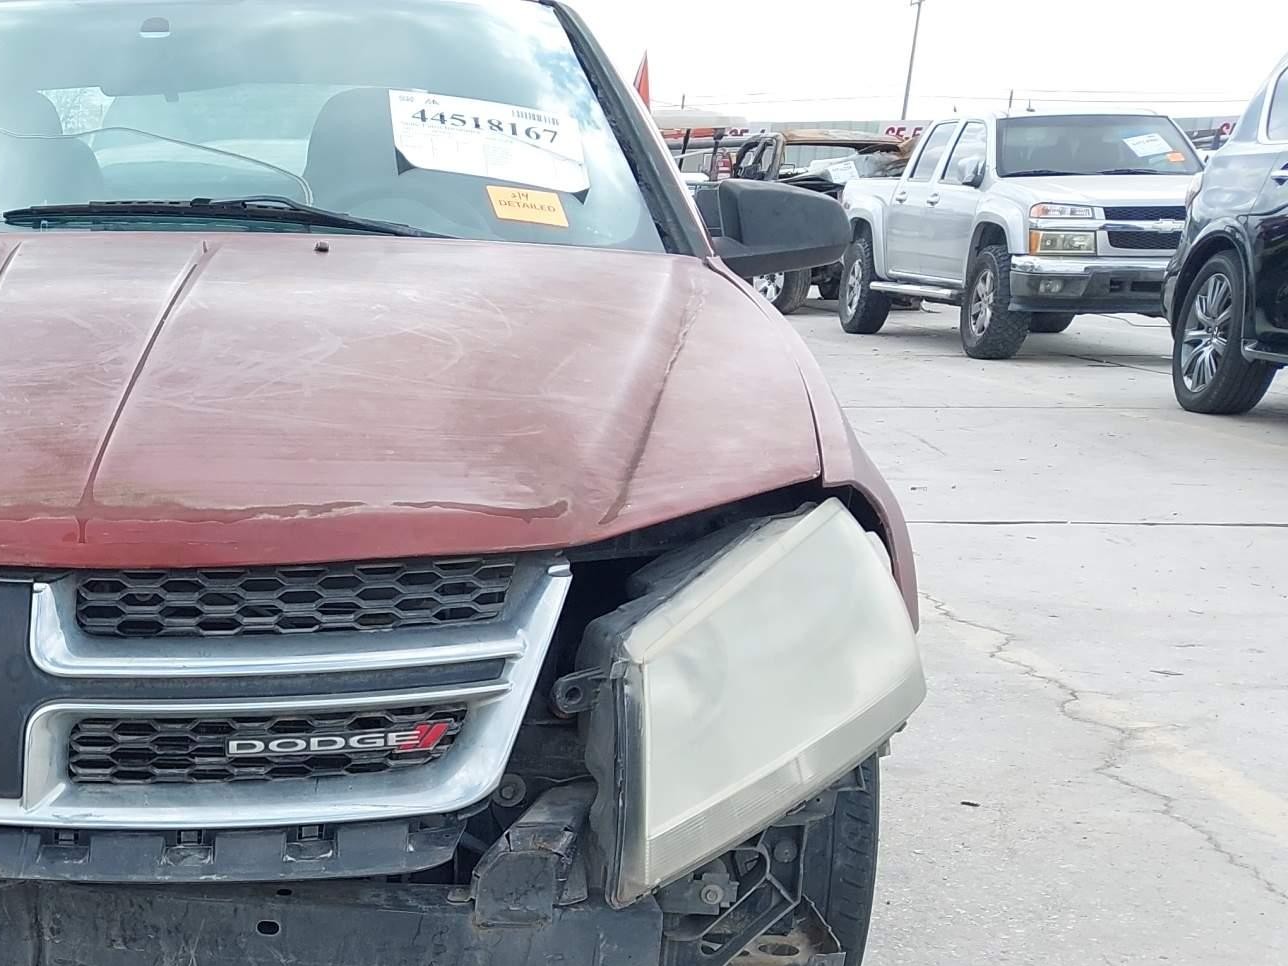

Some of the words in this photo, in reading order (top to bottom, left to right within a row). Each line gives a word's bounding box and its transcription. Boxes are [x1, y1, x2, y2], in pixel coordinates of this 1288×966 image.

[411, 108, 558, 143] 44518167
[498, 199, 556, 213] DETAILED
[227, 730, 421, 755] DODGE
